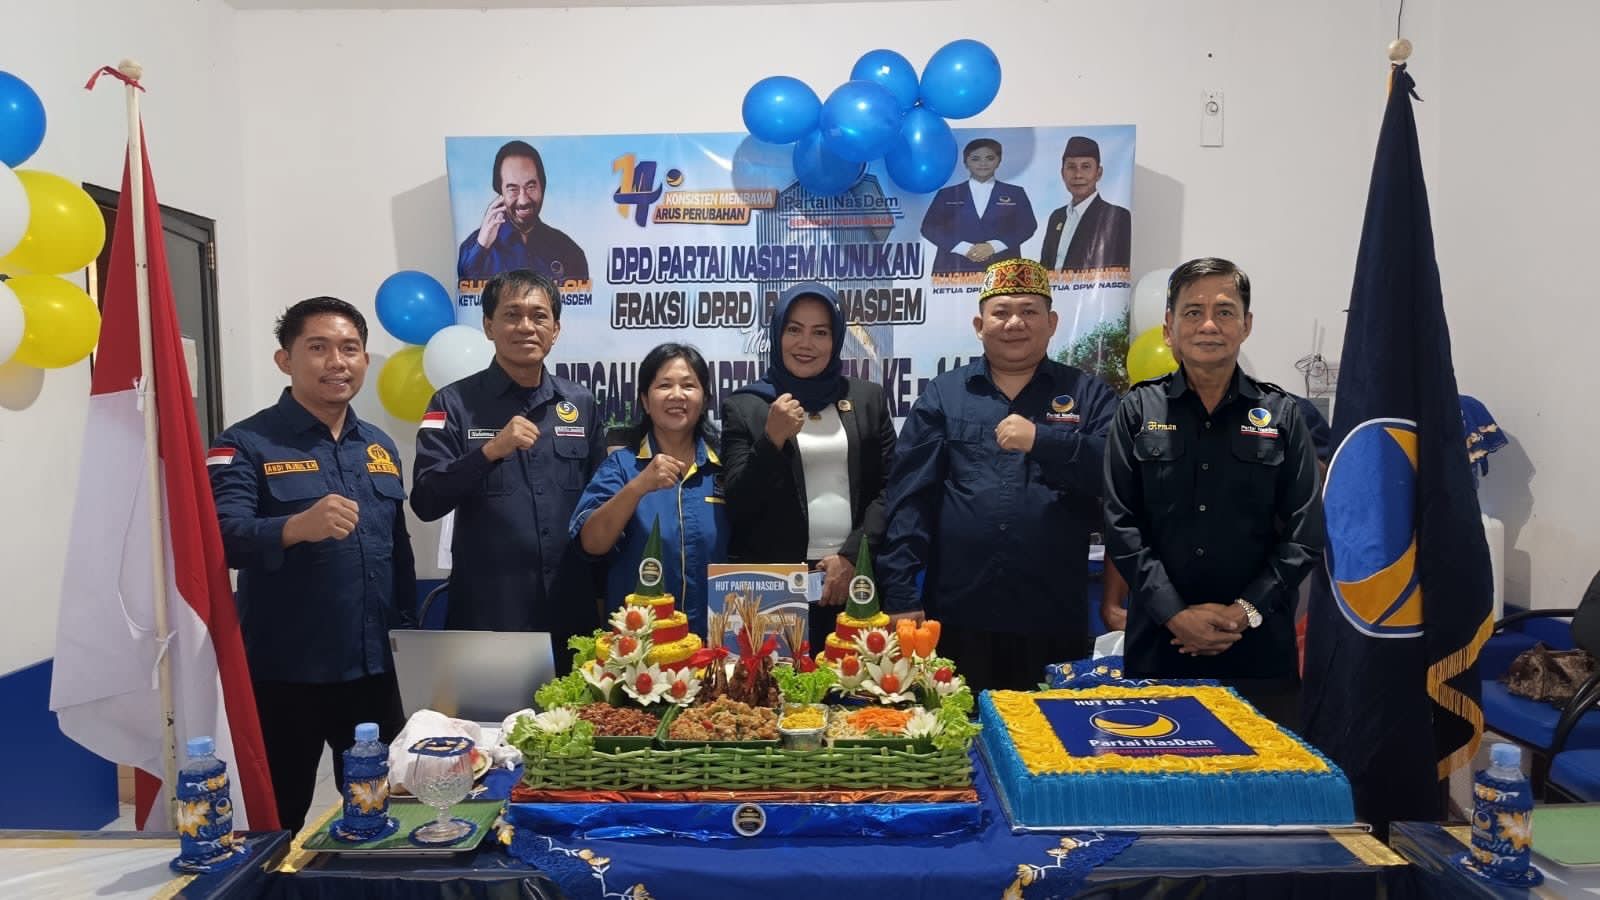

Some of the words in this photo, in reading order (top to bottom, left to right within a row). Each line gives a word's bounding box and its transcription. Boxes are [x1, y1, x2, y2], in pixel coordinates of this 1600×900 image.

[666, 191, 719, 206] KONSISTEN
[720, 190, 773, 205] MEMBAWA
[783, 195, 828, 209] Partai
[834, 194, 899, 209] NasDem
[655, 208, 680, 221] ARUS
[682, 208, 745, 221] PERUBAHAN
[609, 246, 653, 282] DPD
[657, 245, 726, 281] PARTAI
[729, 244, 817, 280] NASDEM
[819, 242, 922, 278] NUNUKAN
[933, 287, 963, 295] KETUA
[459, 295, 483, 306] KETU
[561, 293, 592, 305] ASDEM
[838, 287, 923, 324] NASDEM
[614, 291, 686, 328] FRAKSI
[697, 291, 753, 327] DPRD
[883, 357, 912, 417] KE
[715, 581, 729, 592] HUT
[730, 580, 755, 591] PARTAI
[756, 581, 785, 591] NASDEM
[1088, 739, 1142, 747] Partai
[1144, 738, 1215, 746] NasDem
